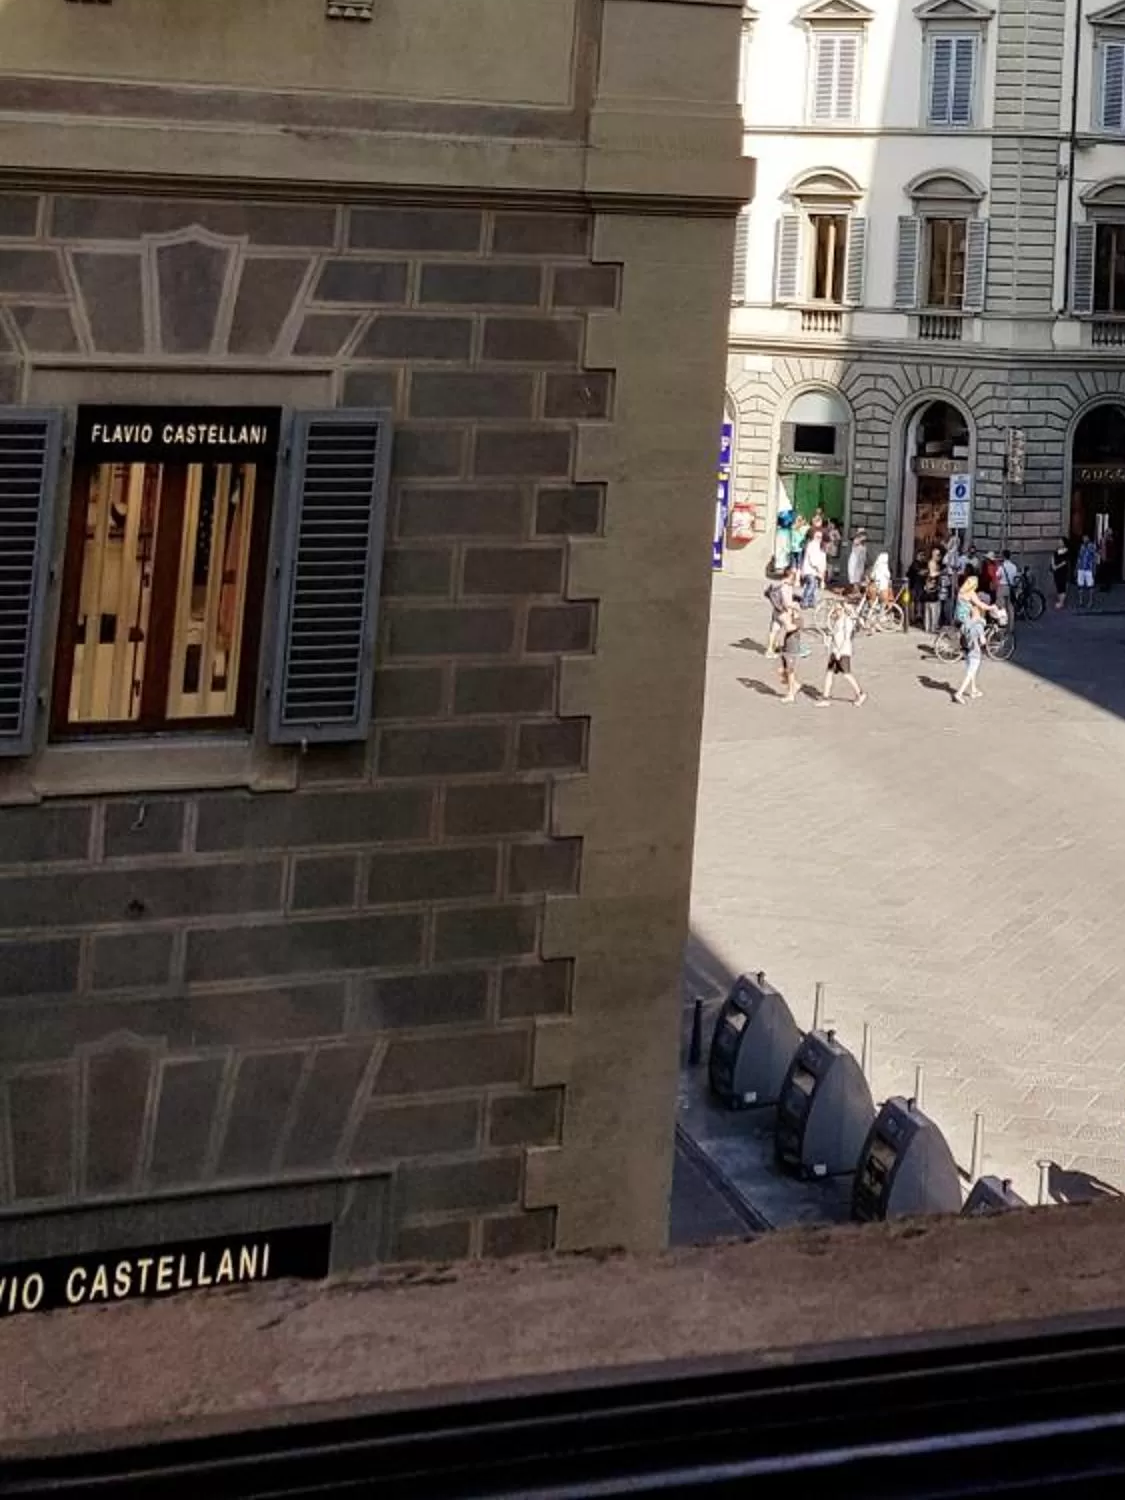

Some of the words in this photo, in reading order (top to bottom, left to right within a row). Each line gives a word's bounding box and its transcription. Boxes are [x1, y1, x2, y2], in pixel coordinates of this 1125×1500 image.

[91, 423, 153, 443] FLAVIO
[162, 423, 267, 445] CASTELLANI
[66, 1243, 269, 1304] CASTELLANI
